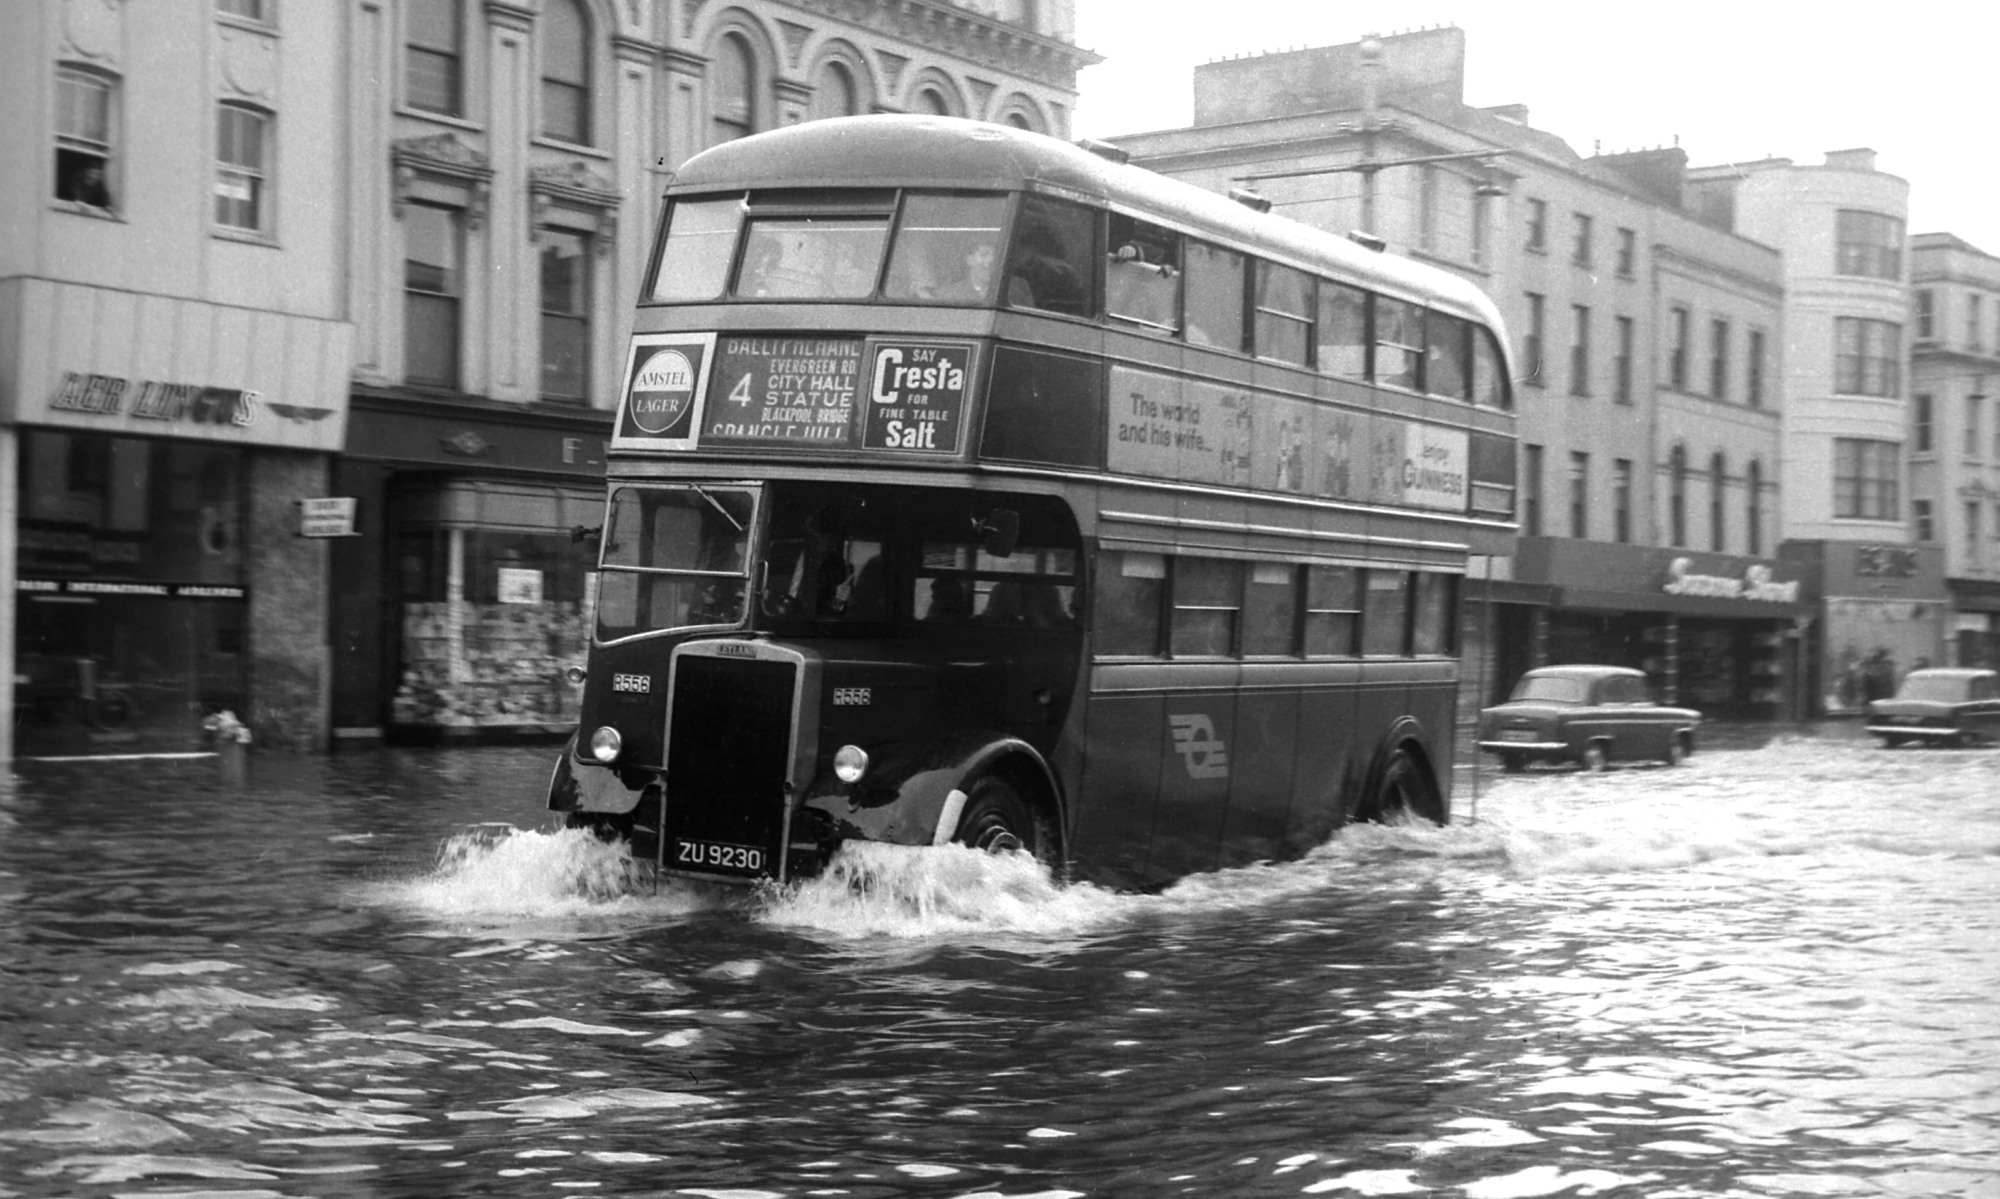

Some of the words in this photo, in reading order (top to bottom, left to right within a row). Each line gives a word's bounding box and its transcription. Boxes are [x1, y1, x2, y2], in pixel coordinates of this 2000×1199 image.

[912, 349, 937, 362] SAY
[770, 359, 837, 374] EVERGREEN
[638, 372, 687, 386] AMSTEL
[767, 375, 806, 390] CITY
[810, 376, 855, 391] HALL
[872, 348, 963, 404] Cresta
[728, 372, 752, 407] 4
[636, 399, 680, 413] LAGER
[765, 391, 854, 407] STATUE
[907, 394, 928, 405] FOR
[761, 407, 812, 423] BLACKPOOL
[817, 408, 850, 424] BRIDGE
[879, 408, 905, 419] FINE
[913, 409, 949, 421] TABLE
[1129, 392, 1157, 418] The
[1161, 402, 1200, 425] world
[885, 420, 936, 449] Salt
[1119, 422, 1147, 443] and
[1151, 423, 1171, 447] his
[614, 674, 650, 692] R556
[679, 842, 704, 863] ZU
[709, 845, 761, 870] 9230
